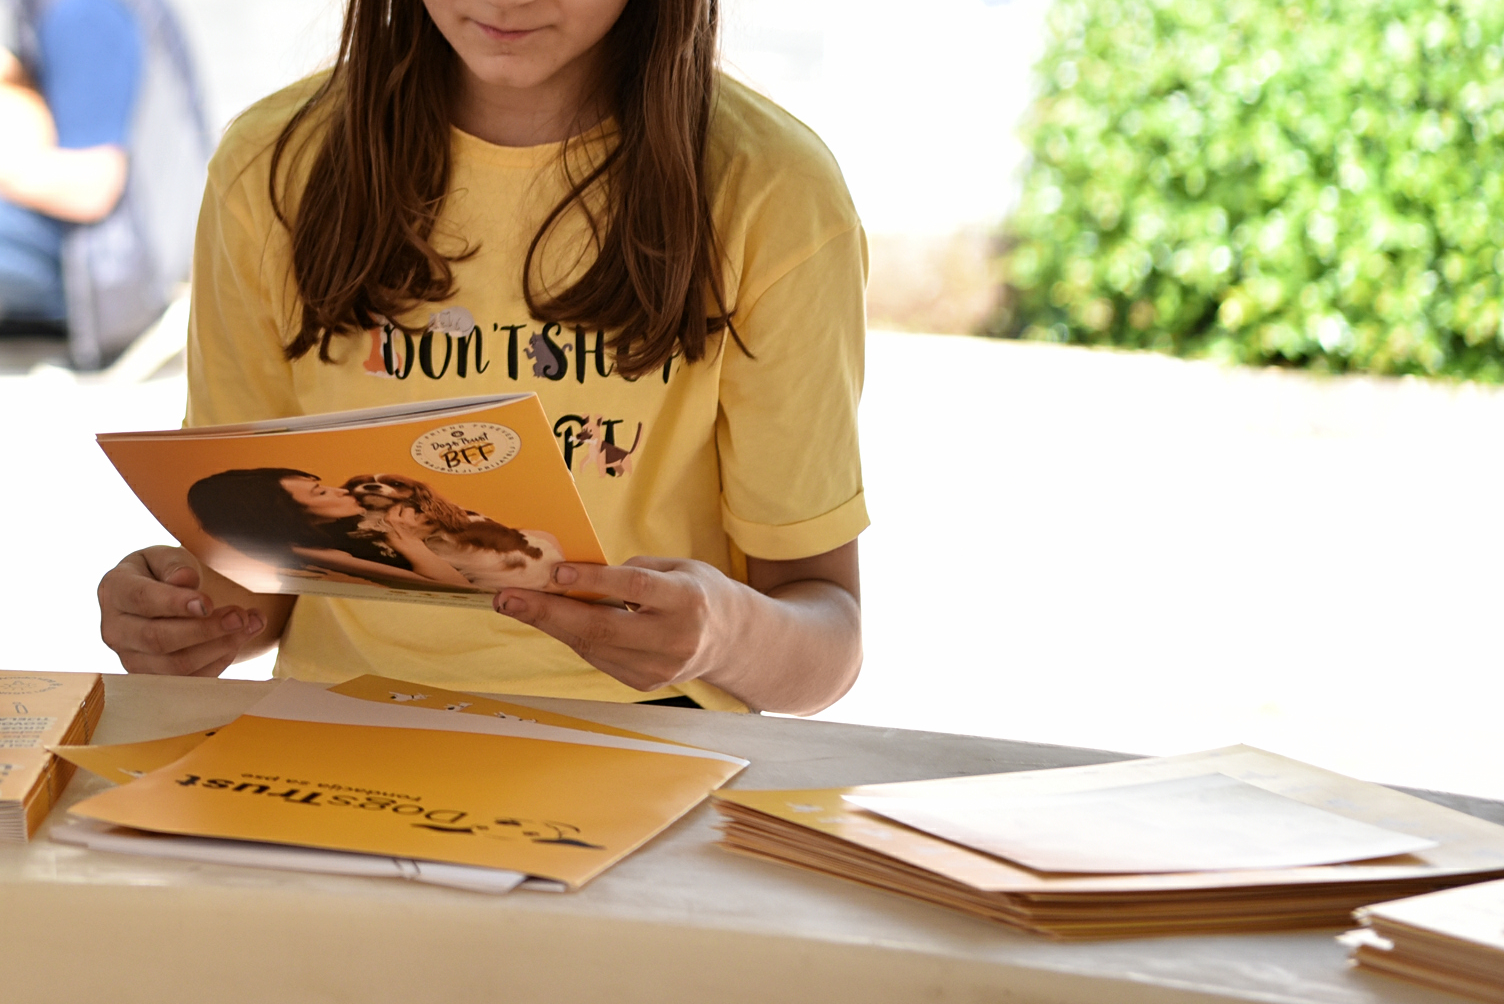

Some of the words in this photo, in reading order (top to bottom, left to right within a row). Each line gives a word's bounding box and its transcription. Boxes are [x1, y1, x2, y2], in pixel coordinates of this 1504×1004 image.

[424, 424, 465, 440] FRIEND
[430, 440, 460, 452] Dogs
[460, 431, 490, 446] Trust
[440, 442, 494, 469] BFF
[175, 773, 469, 824] DogsTrust
